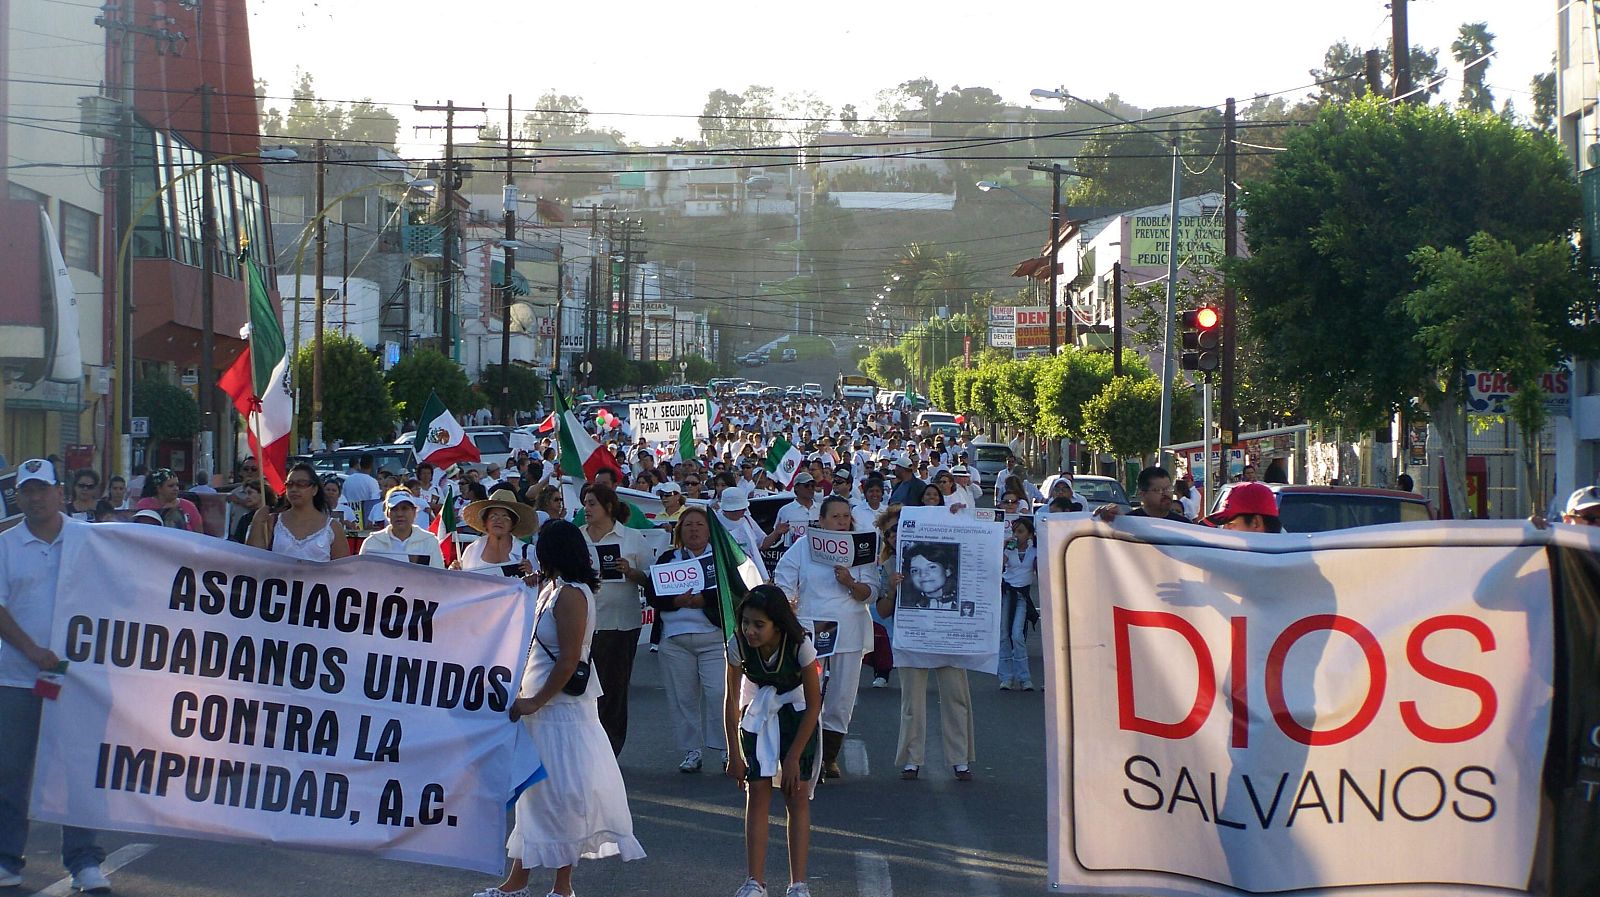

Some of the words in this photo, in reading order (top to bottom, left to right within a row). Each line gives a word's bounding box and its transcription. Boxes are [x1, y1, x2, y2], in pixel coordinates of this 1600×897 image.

[640, 421, 660, 433] PARA
[652, 406, 657, 418] Y
[660, 403, 705, 418] SEGURIDAD
[658, 566, 698, 584] DIOS
[812, 536, 849, 555] DIOS
[168, 565, 440, 644] ASOCIACIÓN
[661, 580, 700, 589] SALVANOS
[65, 614, 349, 696] CIUDADANOS
[363, 651, 513, 714] UNIDOS
[1112, 605, 1499, 749] DIOS
[170, 689, 341, 758] CONTRA
[353, 713, 403, 763] LA
[94, 742, 361, 826] IMPUNIDAD,
[376, 778, 459, 828] A.C.
[1122, 753, 1498, 831] SALVANOS
